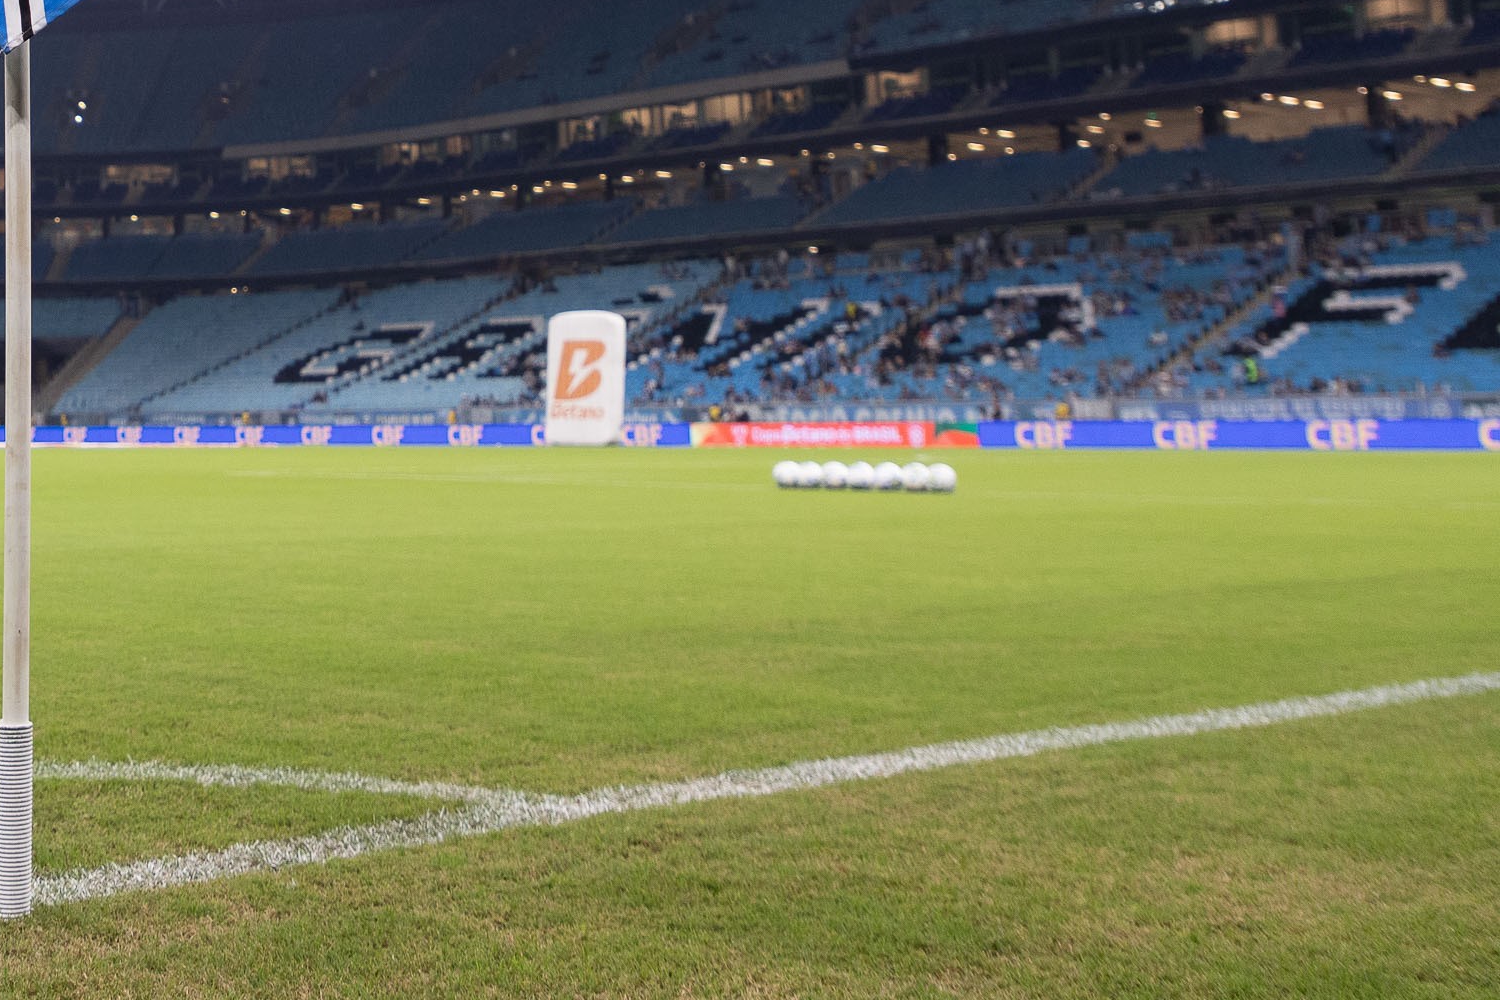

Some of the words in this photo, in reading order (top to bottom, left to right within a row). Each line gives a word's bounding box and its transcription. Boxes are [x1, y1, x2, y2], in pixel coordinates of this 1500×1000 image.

[235, 426, 265, 444] CBF
[301, 426, 333, 444] CBF
[372, 425, 405, 445] CBF
[448, 424, 484, 446] CBF
[621, 424, 663, 446] CBF
[1015, 421, 1074, 449] CBF
[1153, 420, 1218, 449] CBF
[1306, 419, 1380, 450] CBF
